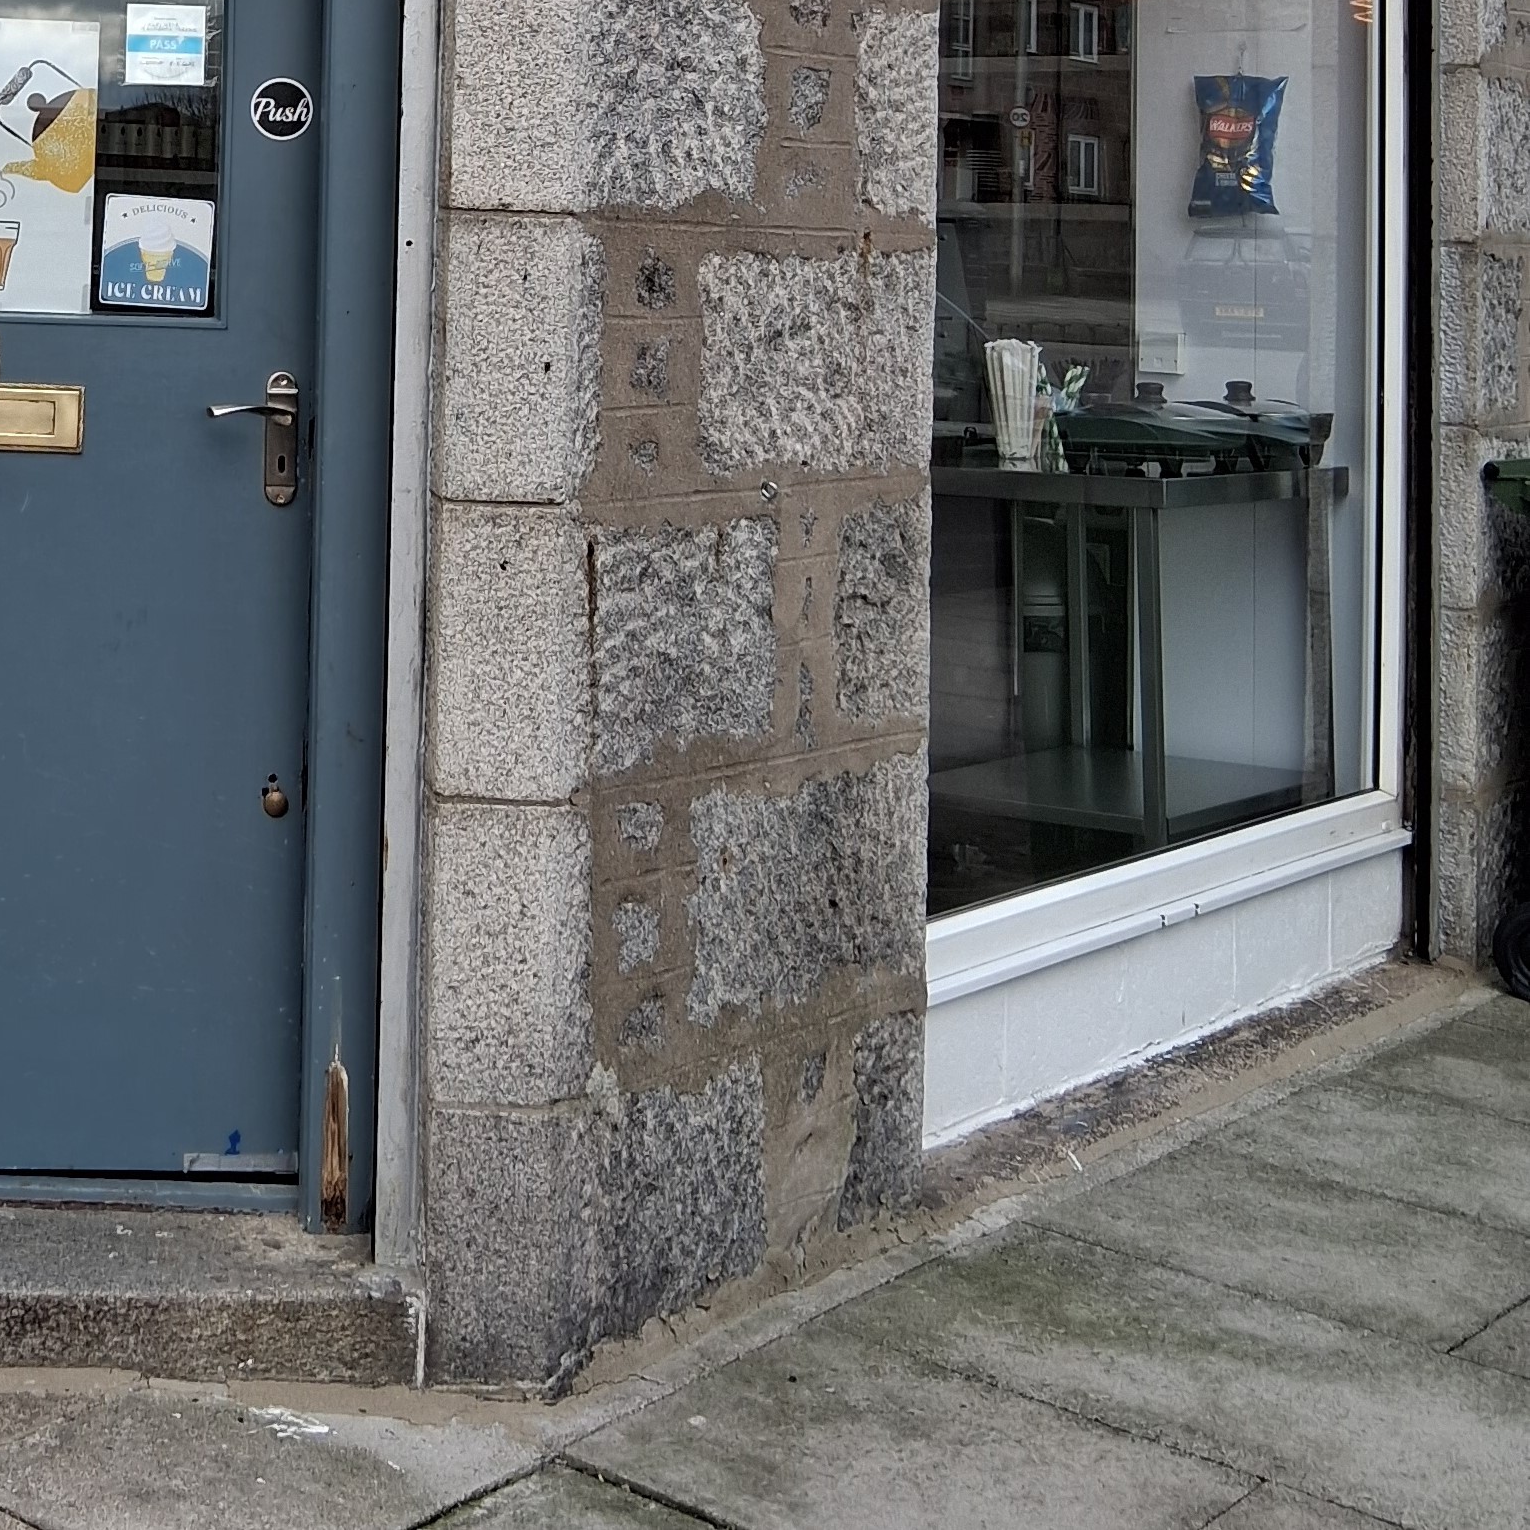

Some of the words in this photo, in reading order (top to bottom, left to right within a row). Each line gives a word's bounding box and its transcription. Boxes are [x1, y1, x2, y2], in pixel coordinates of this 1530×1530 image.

[149, 38, 178, 51] PASS
[255, 97, 309, 123] Push
[1210, 117, 1254, 133] WALKERS
[132, 204, 189, 220] DELICIOUS
[107, 281, 136, 299] ICE
[140, 284, 202, 303] CREAM
